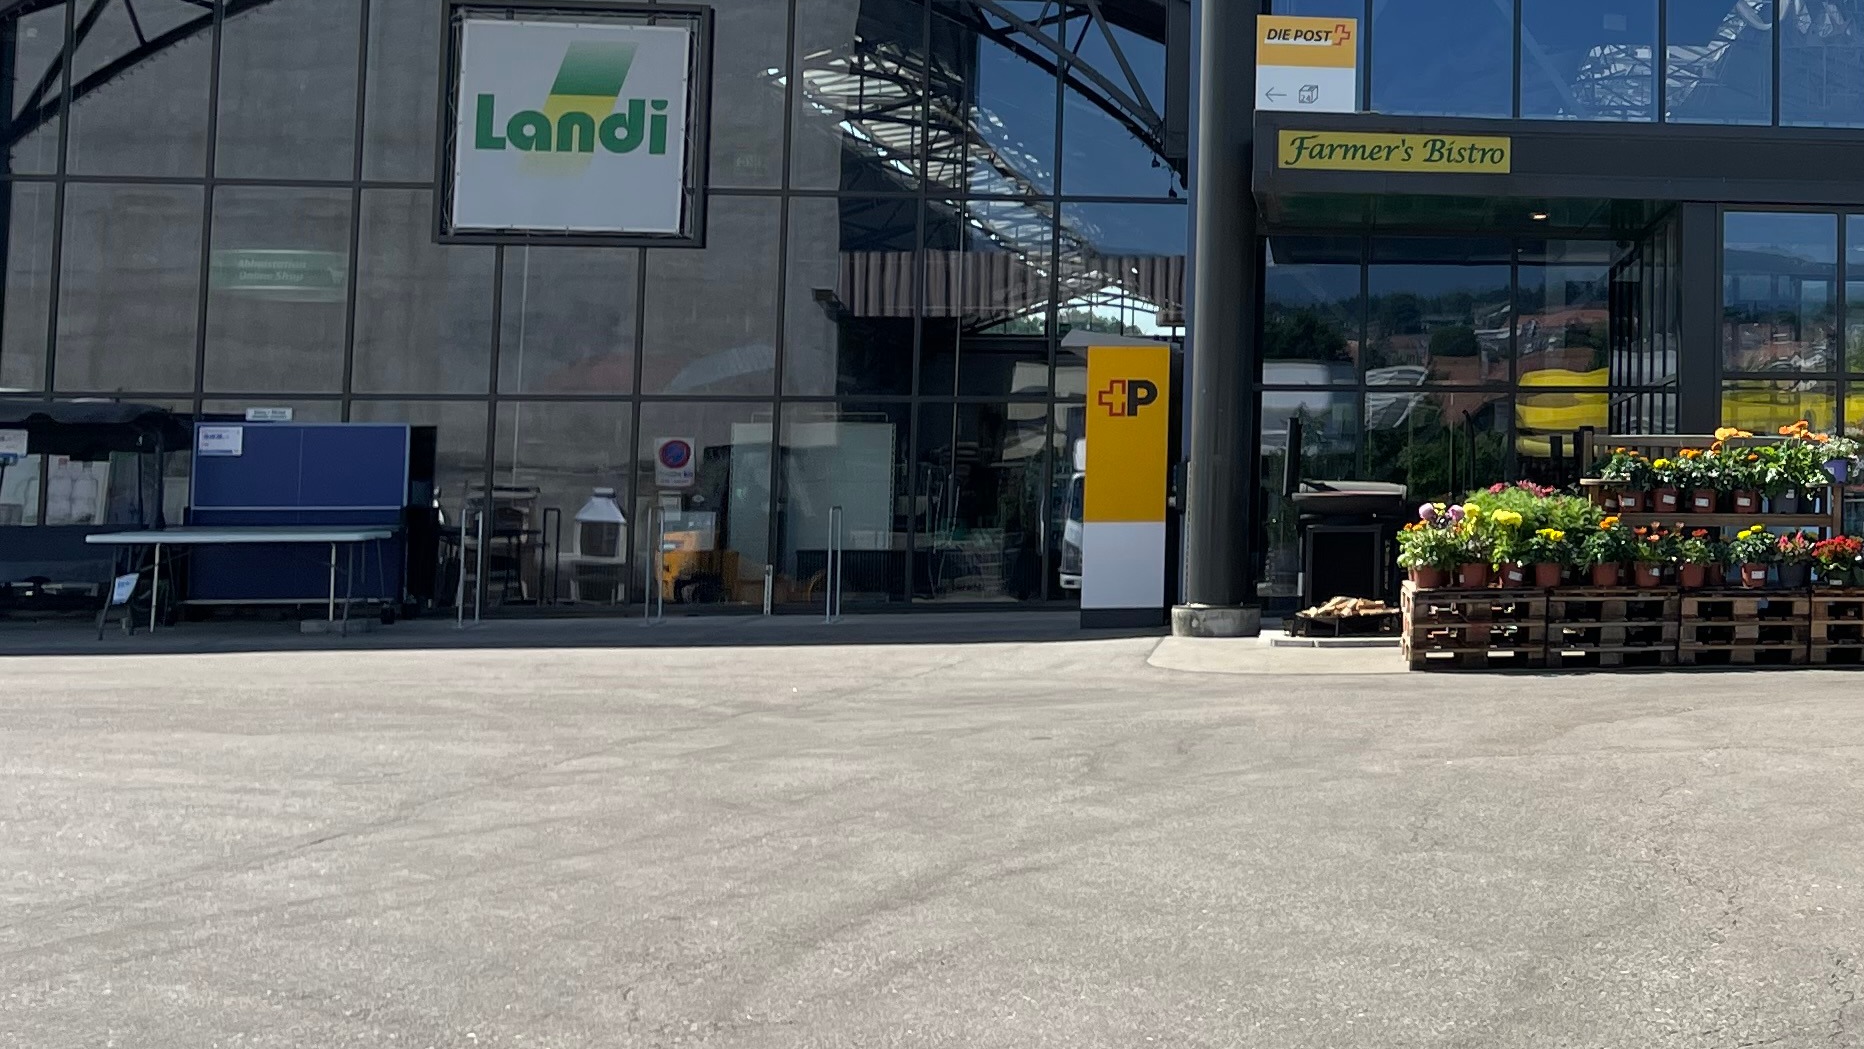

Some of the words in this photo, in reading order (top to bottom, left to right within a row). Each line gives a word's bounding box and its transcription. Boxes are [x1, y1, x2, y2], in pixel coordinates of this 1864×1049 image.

[1267, 28, 1291, 41] DIE
[1294, 29, 1333, 42] POST
[475, 93, 668, 155] Landi
[1284, 135, 1414, 166] Farmer's
[1422, 138, 1505, 164] Bistro
